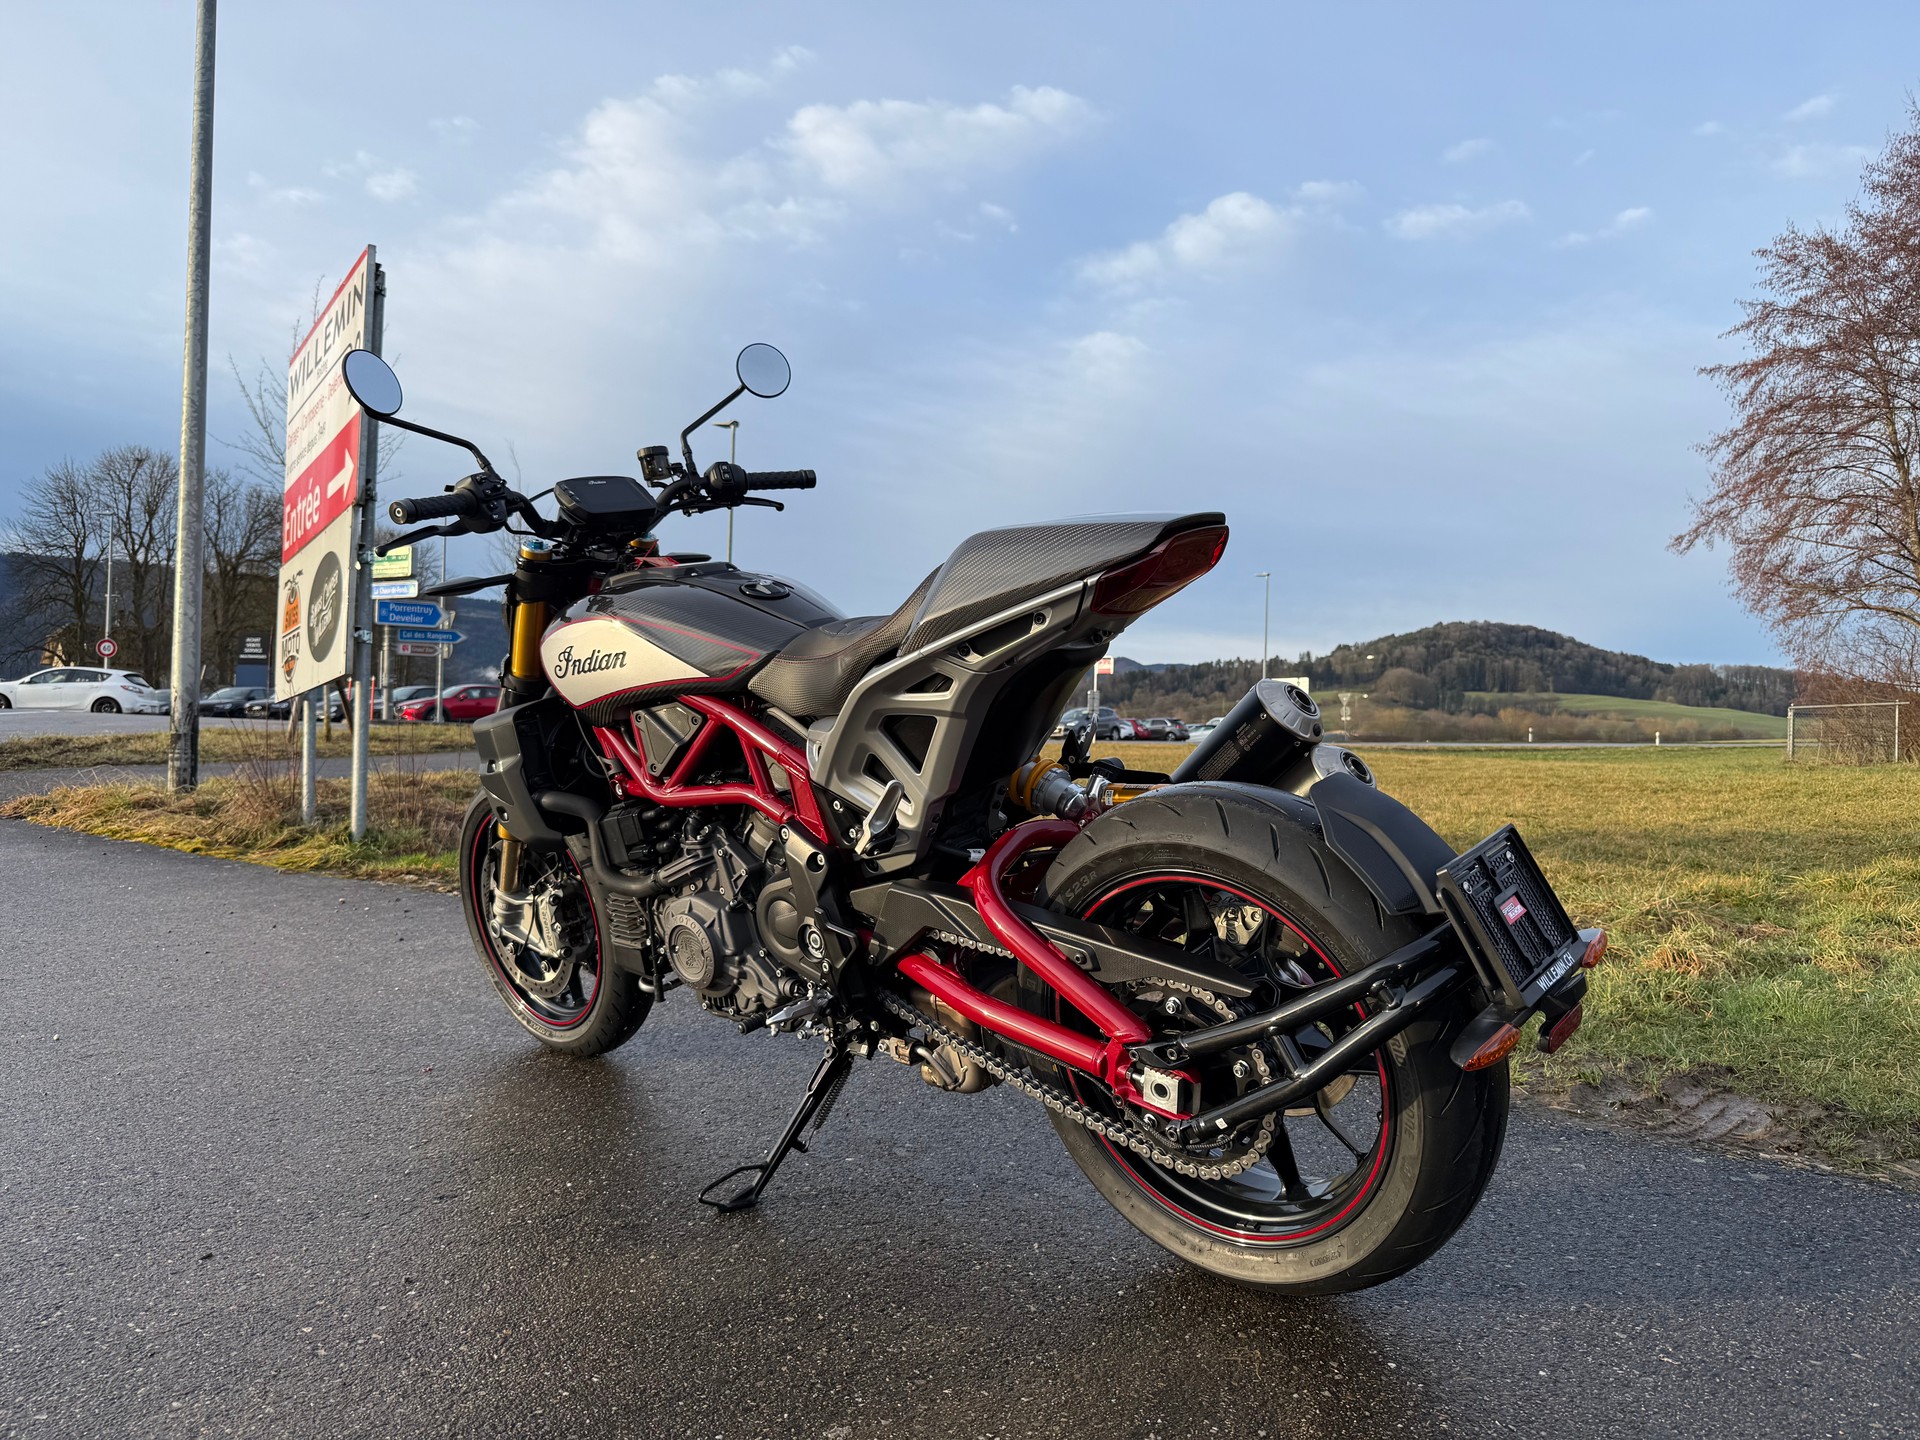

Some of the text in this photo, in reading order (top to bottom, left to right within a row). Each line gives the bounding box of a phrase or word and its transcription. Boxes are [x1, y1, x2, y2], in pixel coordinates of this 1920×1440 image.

[289, 271, 365, 400] WILLEMIN
[283, 478, 321, 552] Entrée
[389, 603, 434, 615] Porrentruy
[389, 613, 424, 623] Develier
[281, 630, 301, 664] MOTO
[554, 645, 627, 679] Indian
[1536, 951, 1574, 992] WILLEMIN.CH
